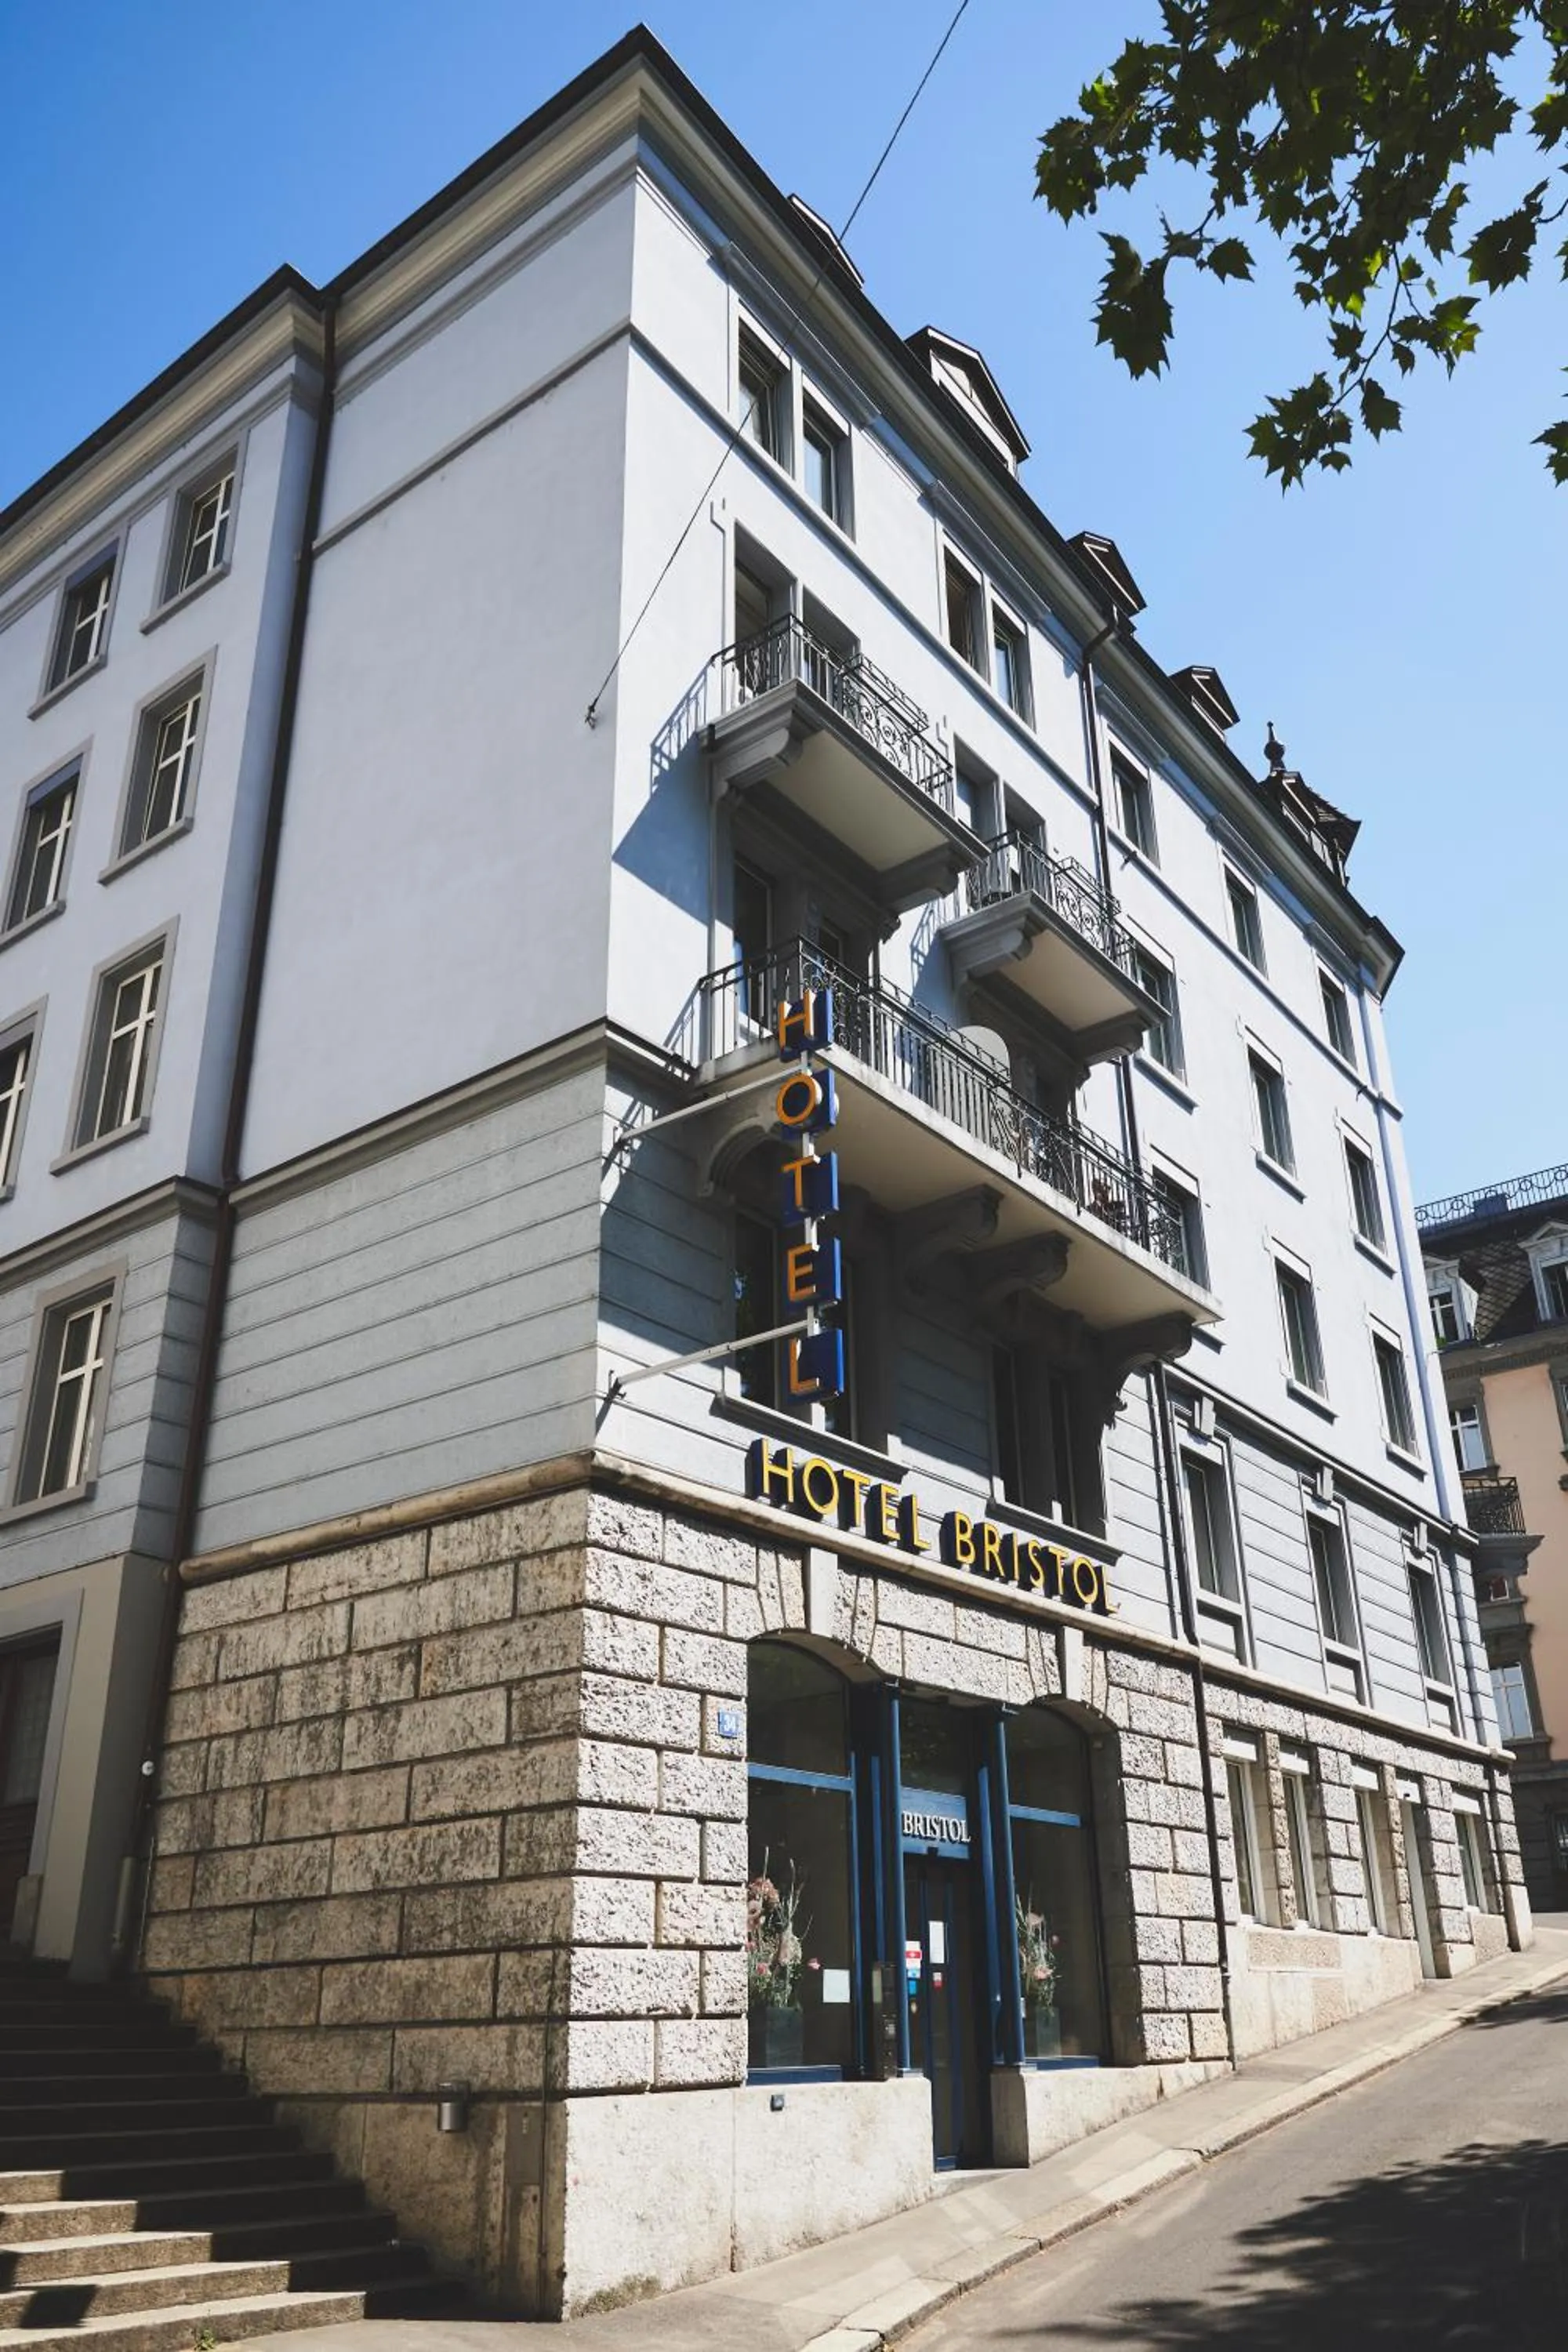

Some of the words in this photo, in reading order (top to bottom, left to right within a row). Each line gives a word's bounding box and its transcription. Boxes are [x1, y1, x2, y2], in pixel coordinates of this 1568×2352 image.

[777, 989, 821, 1395] HOTEL
[759, 1437, 931, 1552] HOTEL
[952, 1510, 1120, 1613] BRISTOL
[723, 1715, 737, 1732] 34
[902, 1810, 971, 1842] BRISTOL
